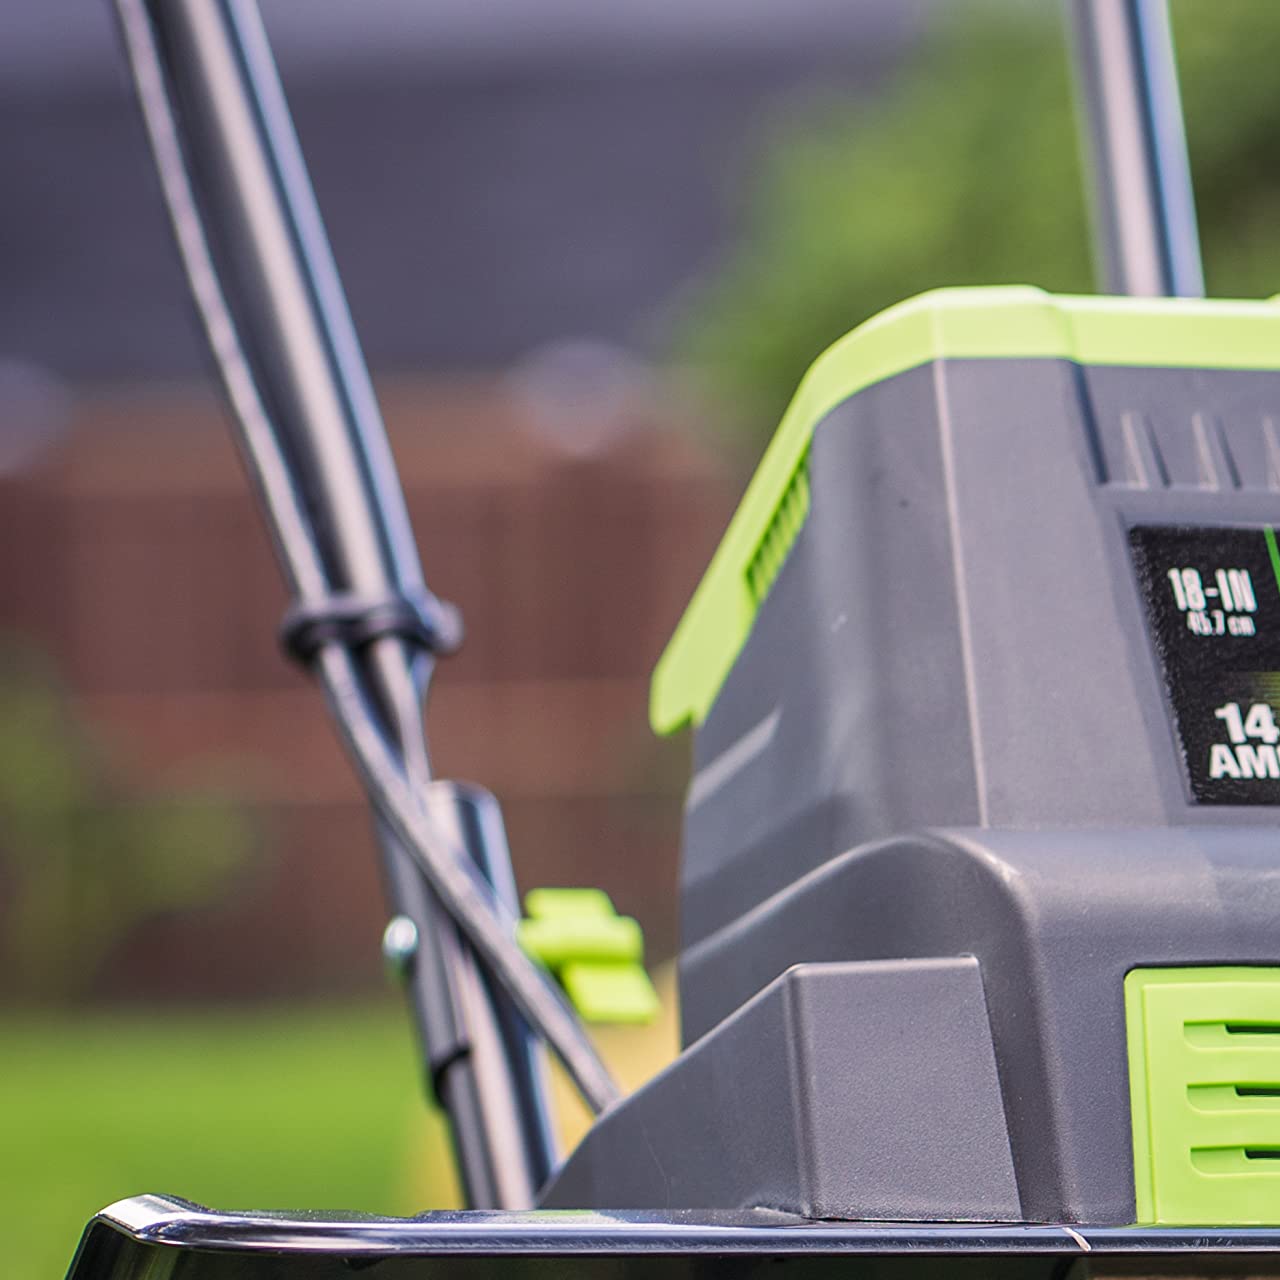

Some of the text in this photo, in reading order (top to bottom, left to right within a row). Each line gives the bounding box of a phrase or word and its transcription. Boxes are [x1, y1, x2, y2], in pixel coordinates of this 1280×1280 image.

[1168, 567, 1257, 612] 18-IN
[1227, 615, 1256, 636] cm
[1214, 702, 1280, 745] 14
